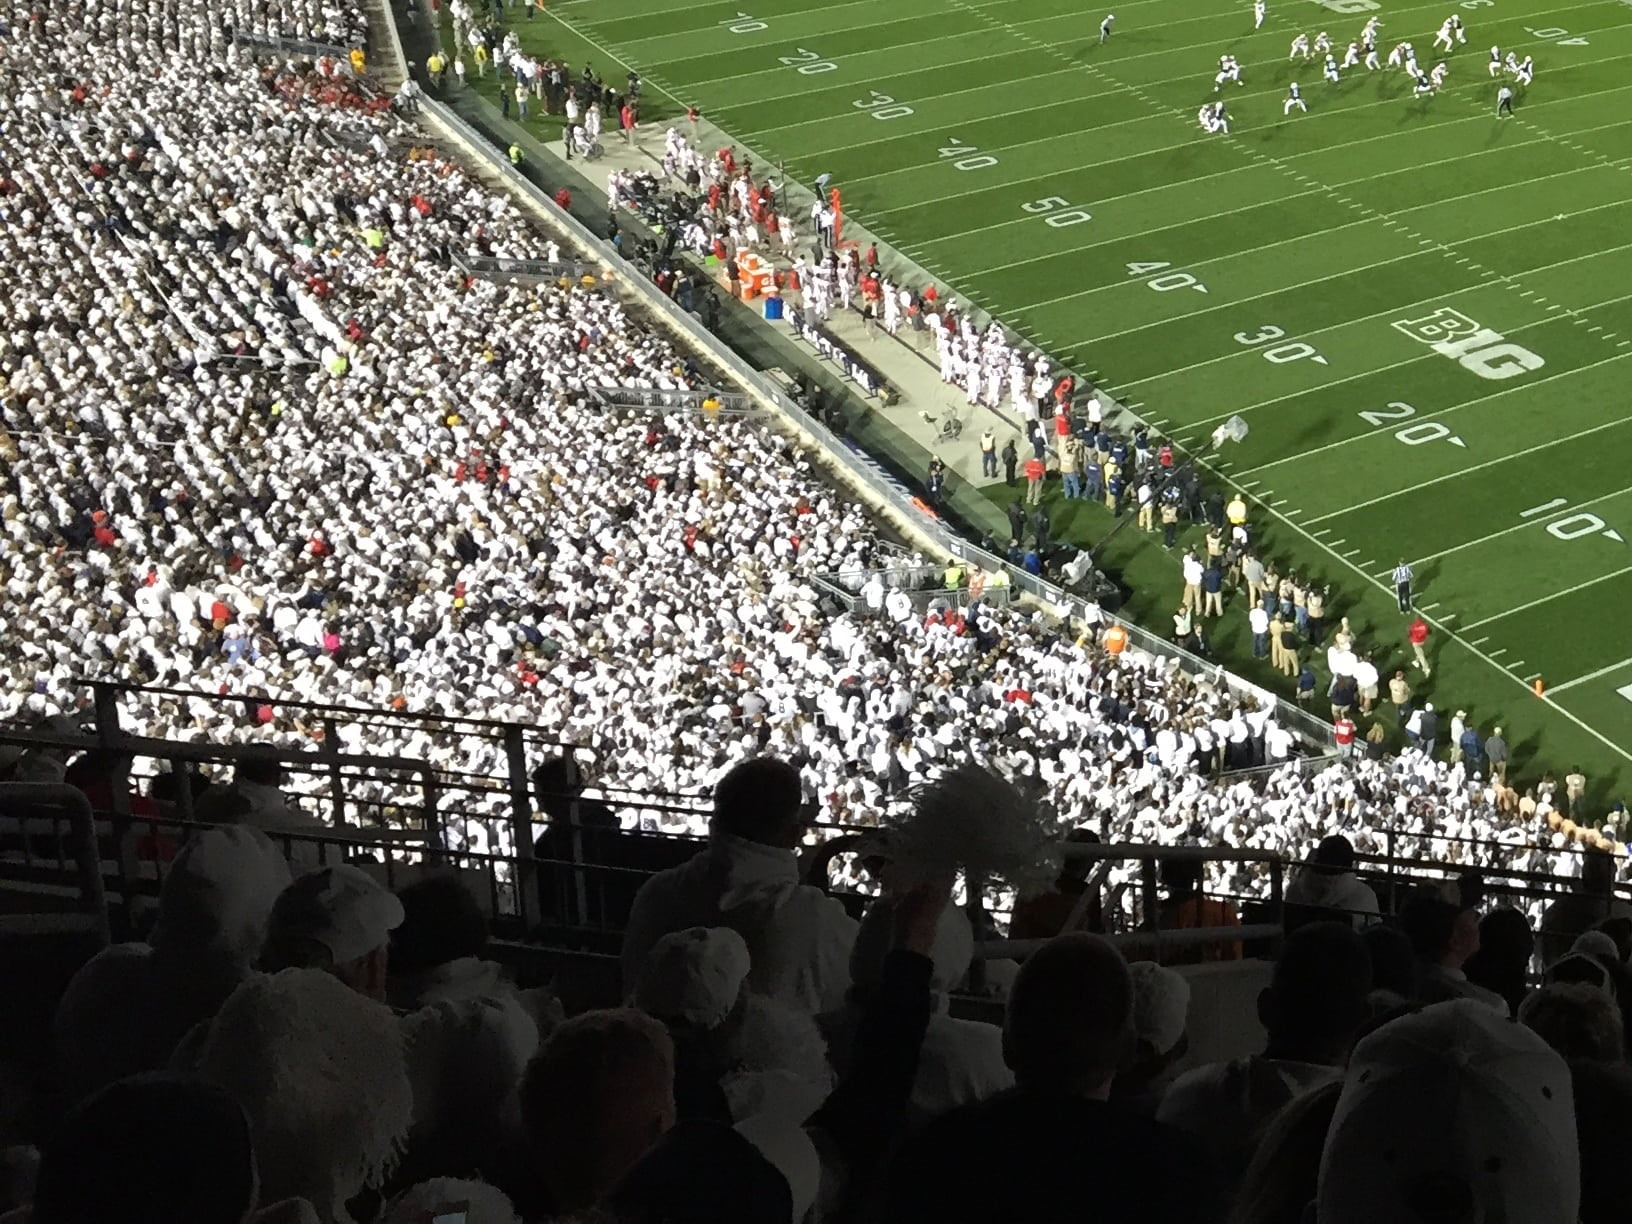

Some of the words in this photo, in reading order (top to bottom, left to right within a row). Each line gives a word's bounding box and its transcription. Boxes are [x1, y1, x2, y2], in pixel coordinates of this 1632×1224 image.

[718, 17, 768, 34] 10
[1530, 27, 1590, 46] 40
[777, 54, 838, 75] 20
[853, 97, 914, 120] 30
[937, 144, 998, 171] 40
[1021, 196, 1092, 228] 50
[1126, 260, 1197, 293] 40
[1232, 324, 1316, 364] 30
[1358, 401, 1450, 448] 20
[1519, 498, 1605, 541] 10
